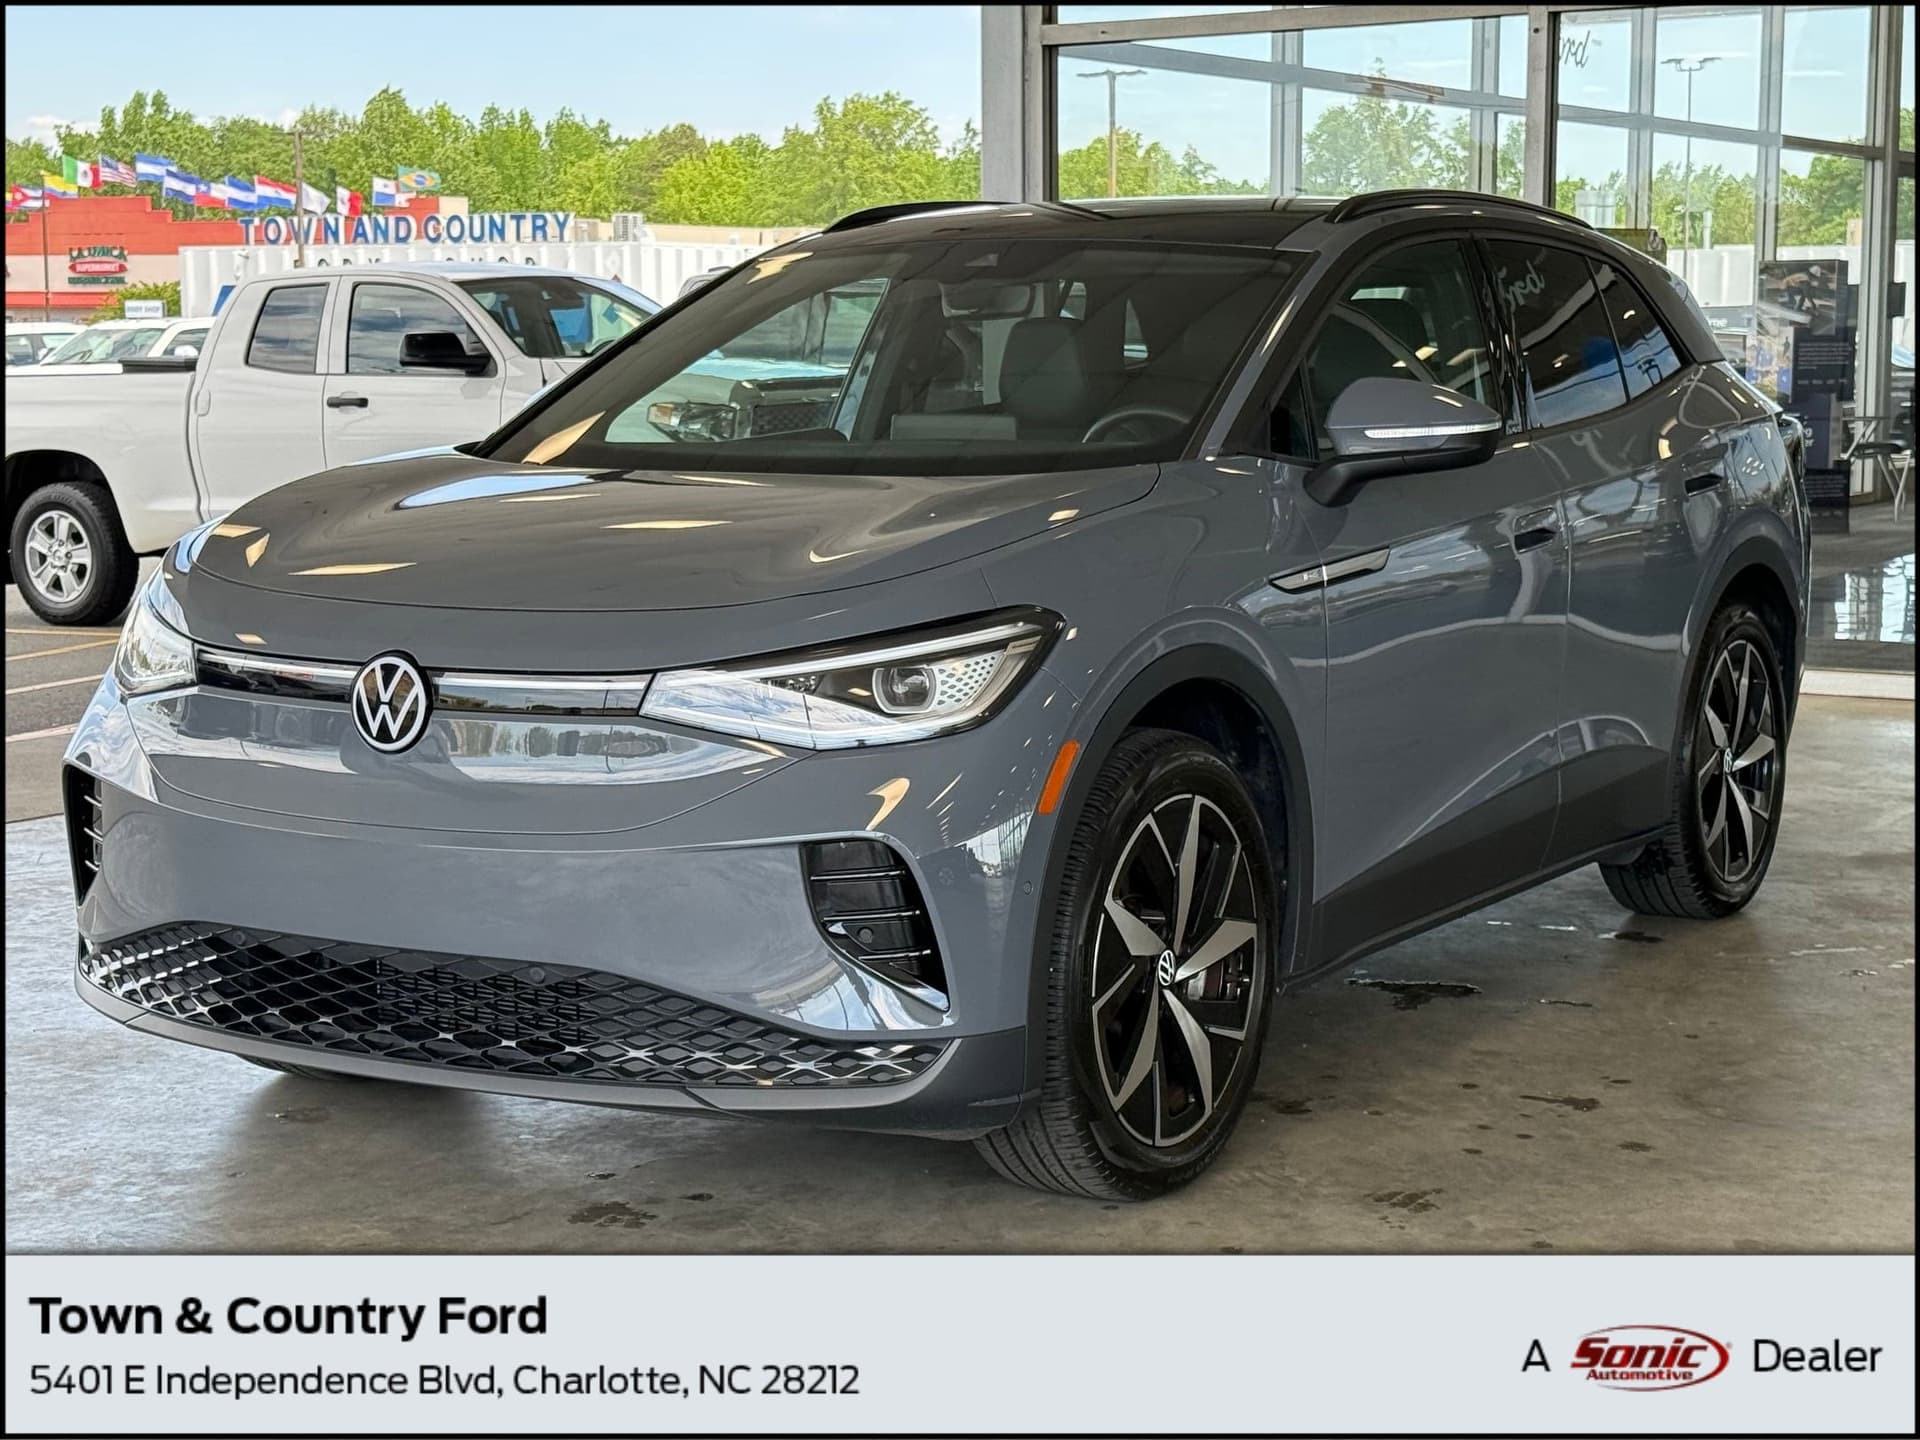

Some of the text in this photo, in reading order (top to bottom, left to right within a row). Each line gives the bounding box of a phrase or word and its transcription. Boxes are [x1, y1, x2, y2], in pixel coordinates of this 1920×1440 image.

[238, 213, 572, 245] TOWN AND COUNTRY
